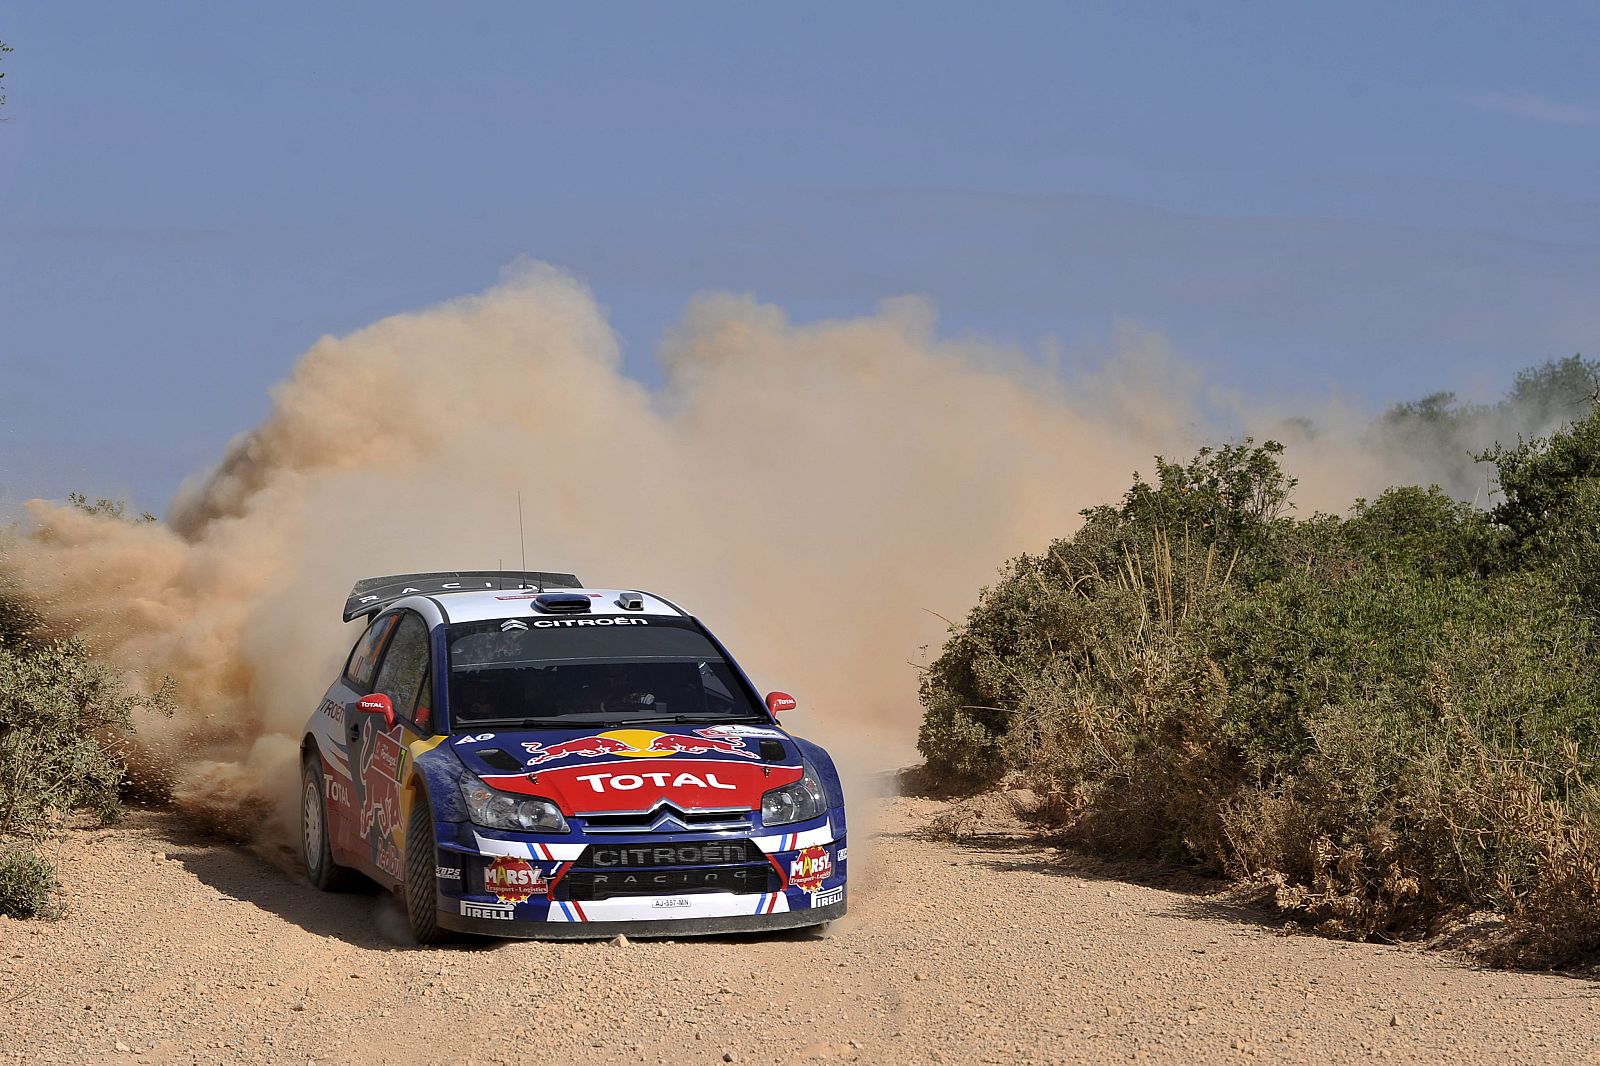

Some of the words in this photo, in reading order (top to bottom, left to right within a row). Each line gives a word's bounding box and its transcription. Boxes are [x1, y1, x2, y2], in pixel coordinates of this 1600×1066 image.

[397, 748, 407, 781] 7
[323, 773, 351, 808] TOTAL
[576, 772, 737, 793] TOTAL
[484, 864, 542, 887] MARSY
[790, 853, 830, 878] MARSY
[486, 884, 514, 893] Transport
[518, 886, 547, 894] Logistics
[810, 885, 843, 909] PIRELLI
[460, 900, 515, 921] PIRELLI
